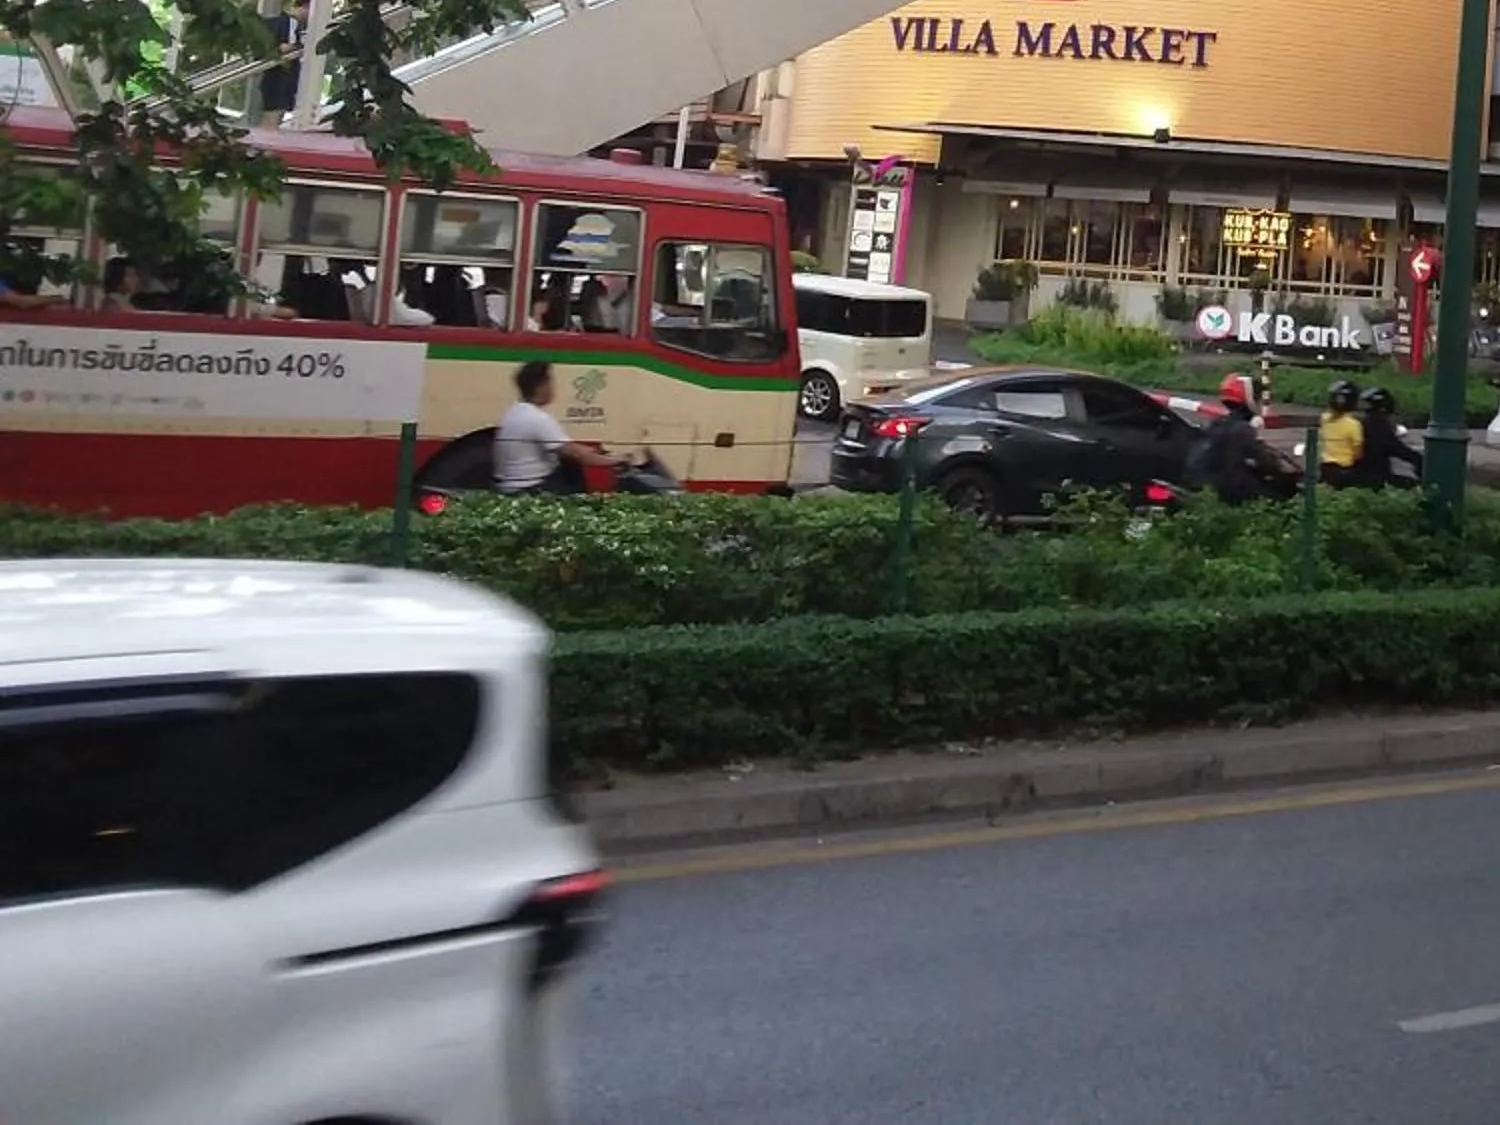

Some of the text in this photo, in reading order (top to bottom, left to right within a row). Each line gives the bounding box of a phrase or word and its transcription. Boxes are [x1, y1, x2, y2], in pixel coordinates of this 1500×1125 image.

[889, 16, 1217, 69] VILLA MARKET
[276, 352, 345, 378] 40%
